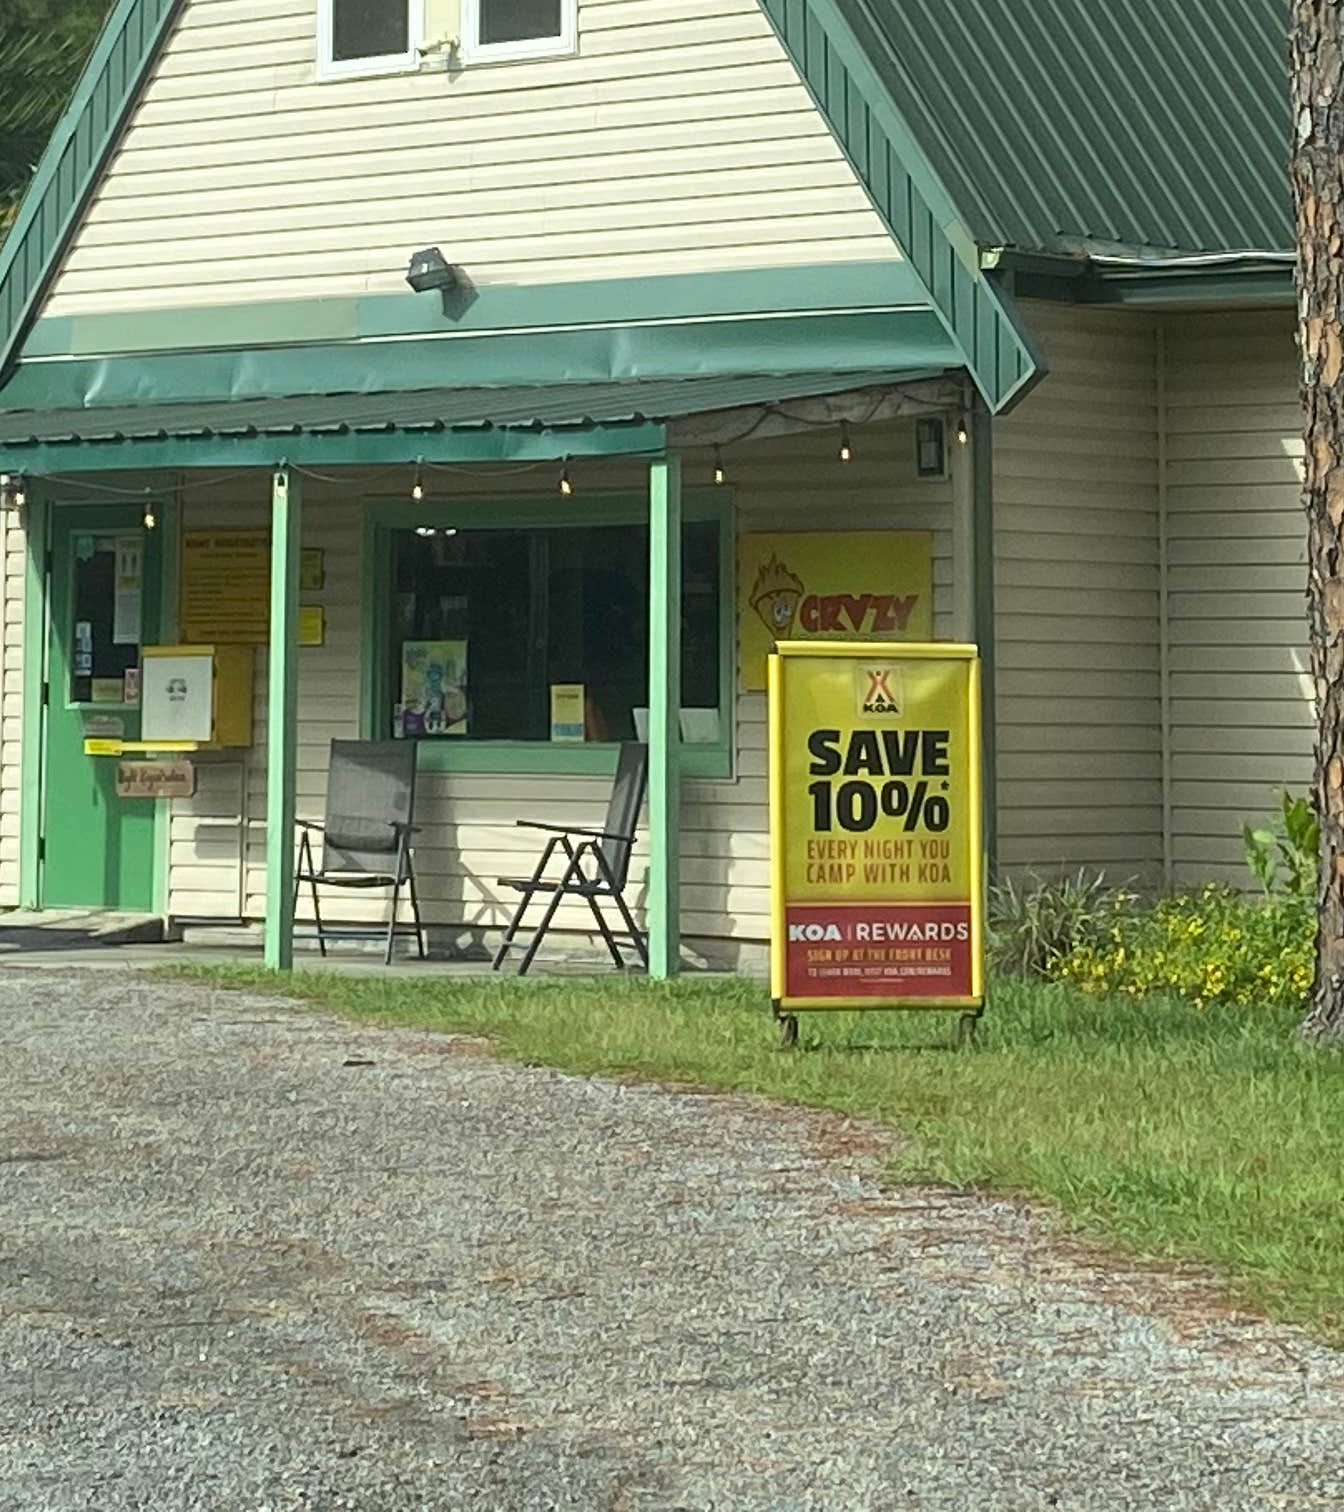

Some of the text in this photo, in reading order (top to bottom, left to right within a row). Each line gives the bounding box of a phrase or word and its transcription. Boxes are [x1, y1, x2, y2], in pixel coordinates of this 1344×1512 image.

[863, 703, 898, 713] KOA
[808, 729, 950, 777] SAVE
[807, 839, 950, 860] EVERY NIGHT YOU
[807, 862, 952, 884] CAMP WITH KOA
[788, 922, 969, 942] KOA REWARDS
